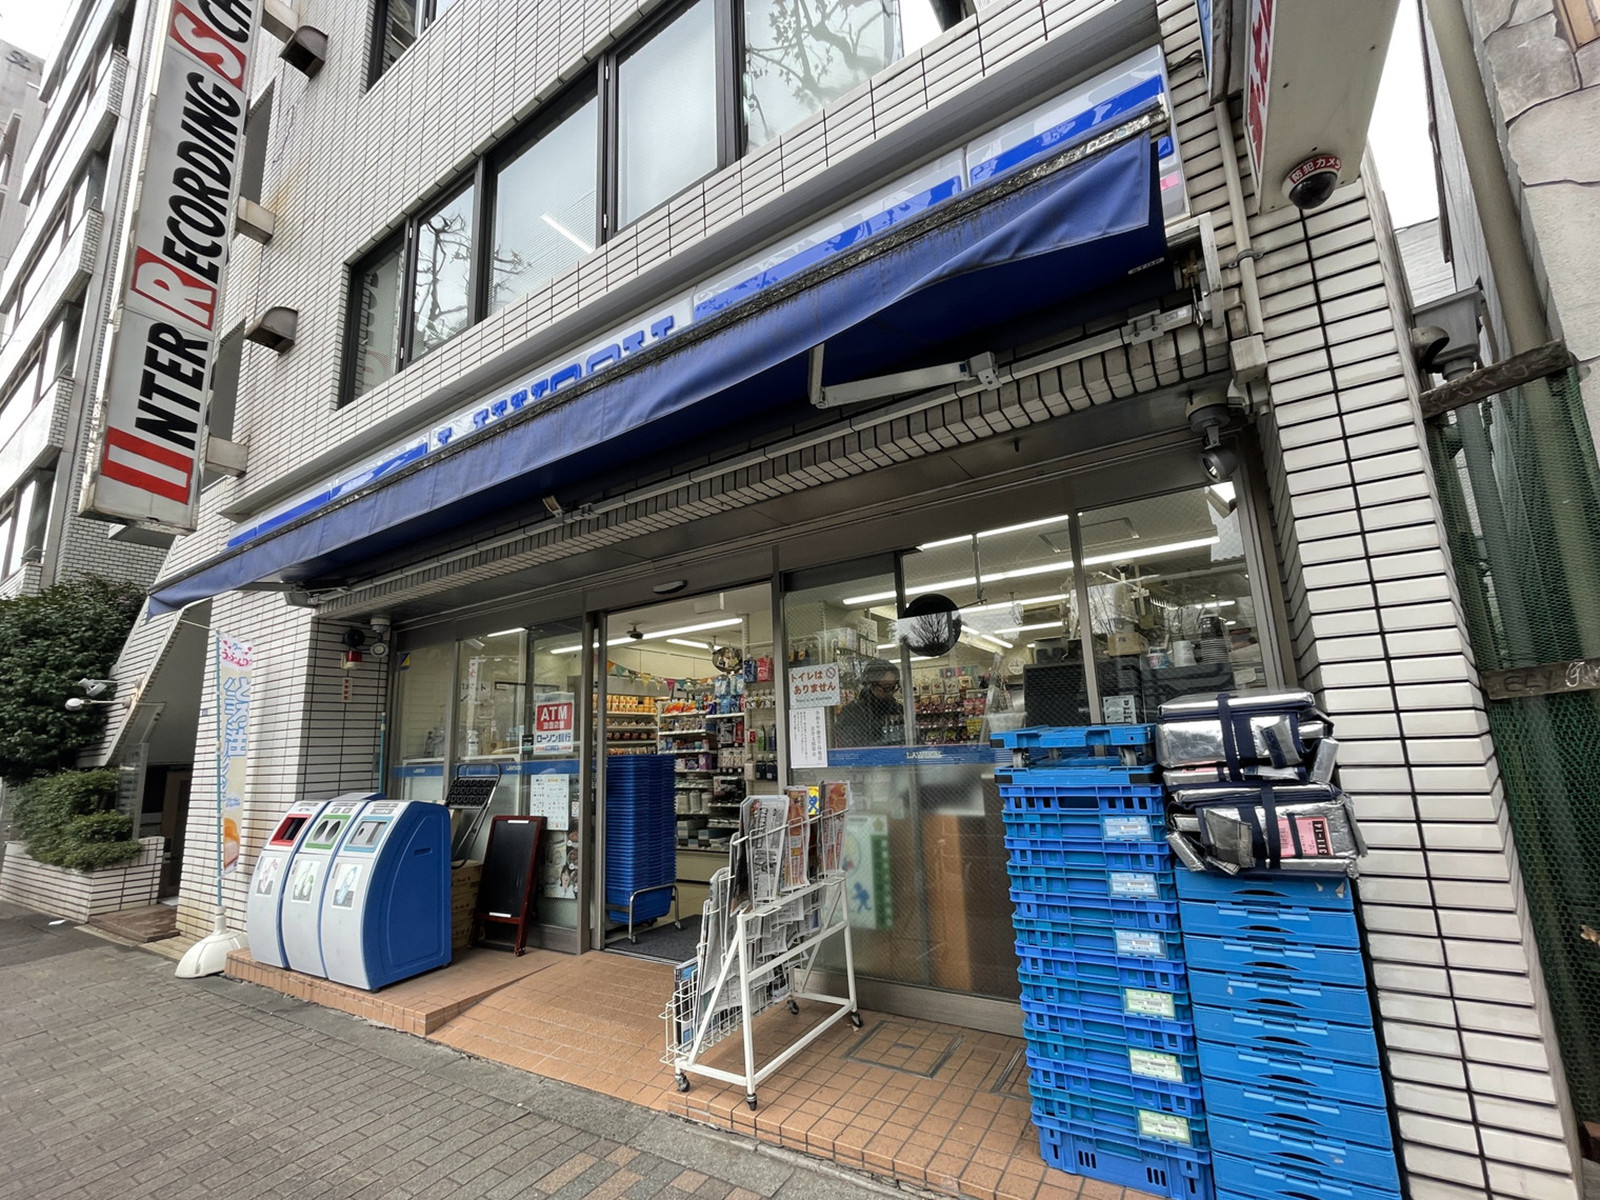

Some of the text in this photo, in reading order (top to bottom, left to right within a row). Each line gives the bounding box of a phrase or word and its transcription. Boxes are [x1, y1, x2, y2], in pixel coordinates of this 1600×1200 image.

[135, 72, 241, 325] RECORDING
[106, 322, 208, 489] INTER
[791, 670, 824, 683] トイレは
[793, 681, 836, 695] ありません
[540, 705, 568, 721] ATM
[1314, 823, 1327, 854] 311-14
